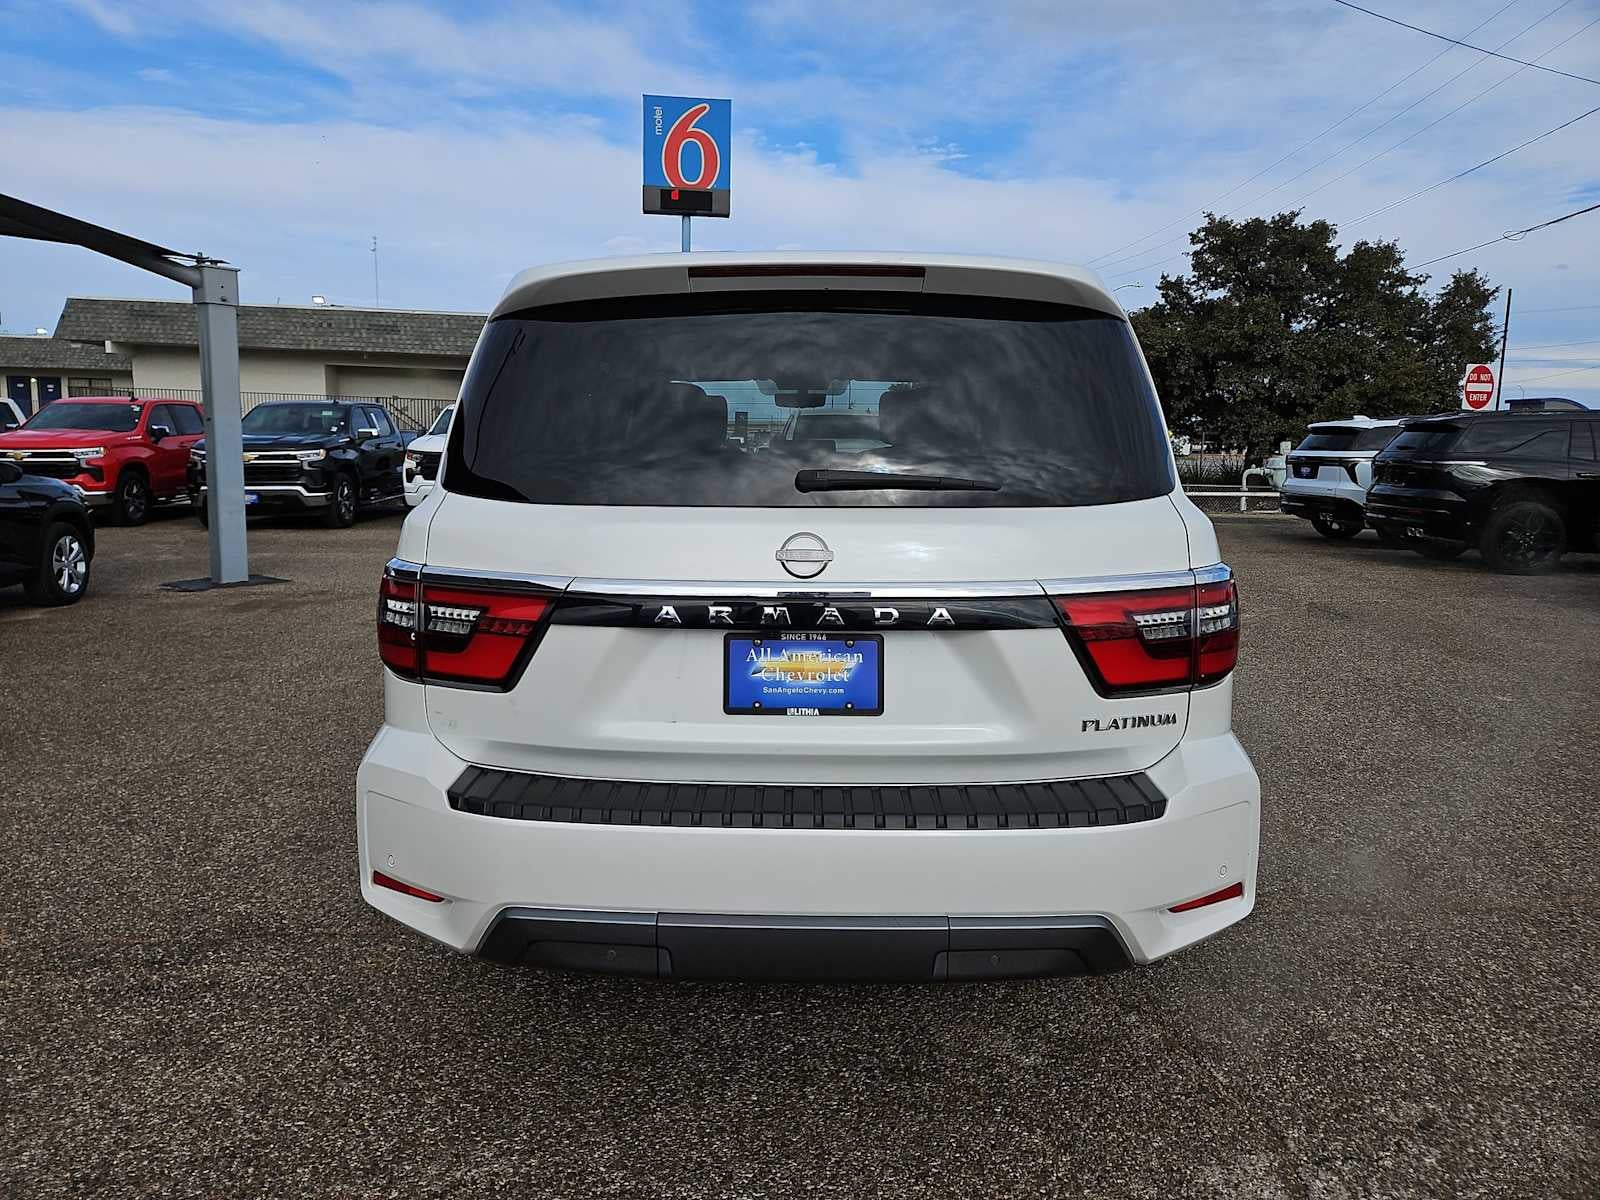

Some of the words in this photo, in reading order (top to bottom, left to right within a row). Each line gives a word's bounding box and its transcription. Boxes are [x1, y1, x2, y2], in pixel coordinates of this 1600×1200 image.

[653, 106, 662, 135] motel
[662, 103, 720, 189] 6
[654, 606, 955, 625] ARMADA
[746, 647, 772, 662] All
[778, 648, 863, 663] American
[760, 666, 850, 682] Chevrolet
[762, 686, 845, 695] SanAngeloChevy.com
[1081, 713, 1176, 732] PLATINUM
